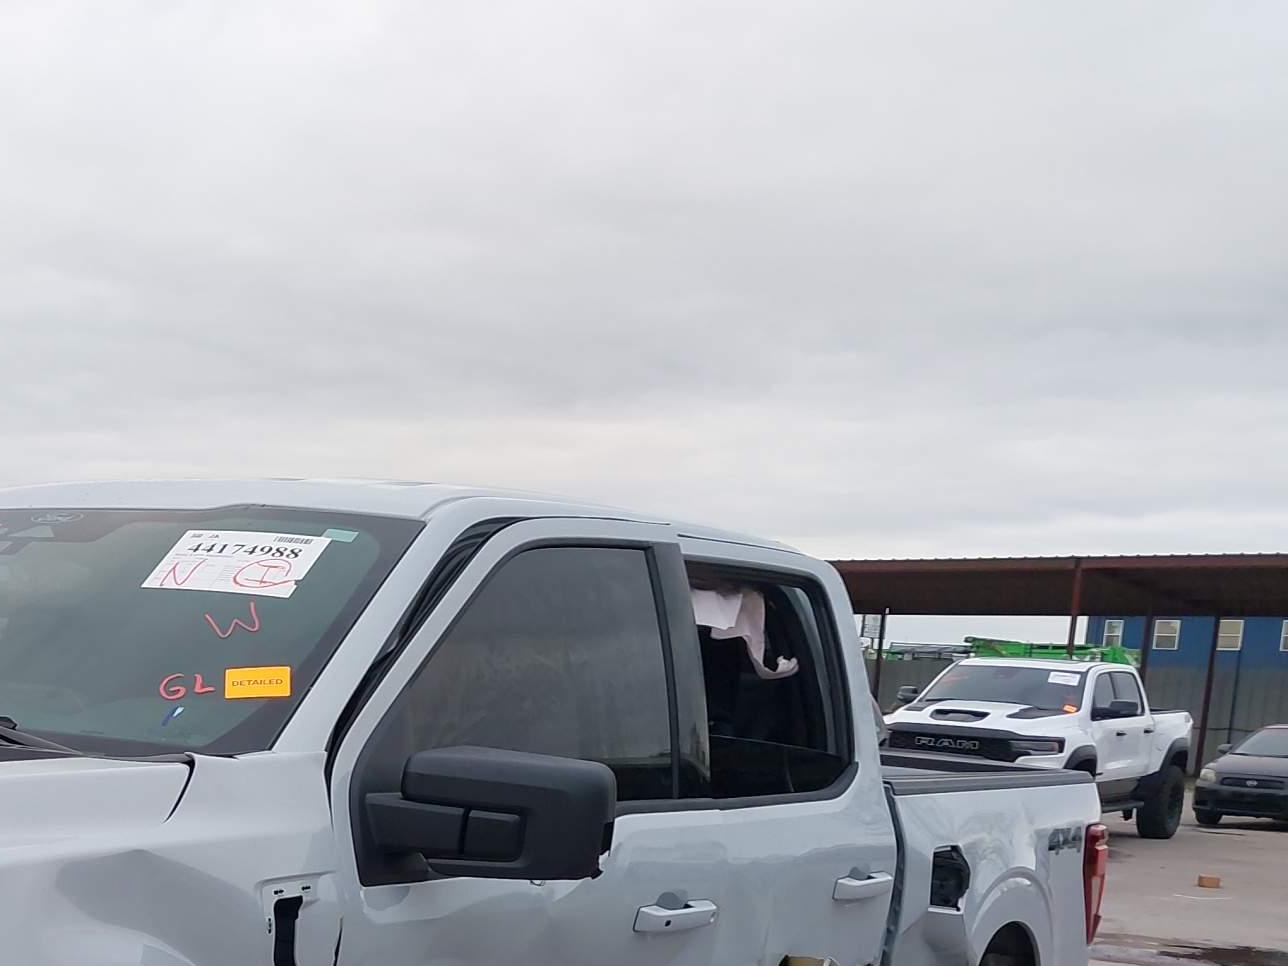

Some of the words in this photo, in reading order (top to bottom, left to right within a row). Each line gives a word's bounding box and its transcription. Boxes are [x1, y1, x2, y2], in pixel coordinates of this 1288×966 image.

[187, 542, 303, 560] 44174988
[160, 558, 207, 587] N
[203, 600, 260, 638] W
[231, 678, 284, 687] DETAILED
[914, 736, 980, 750] RAM
